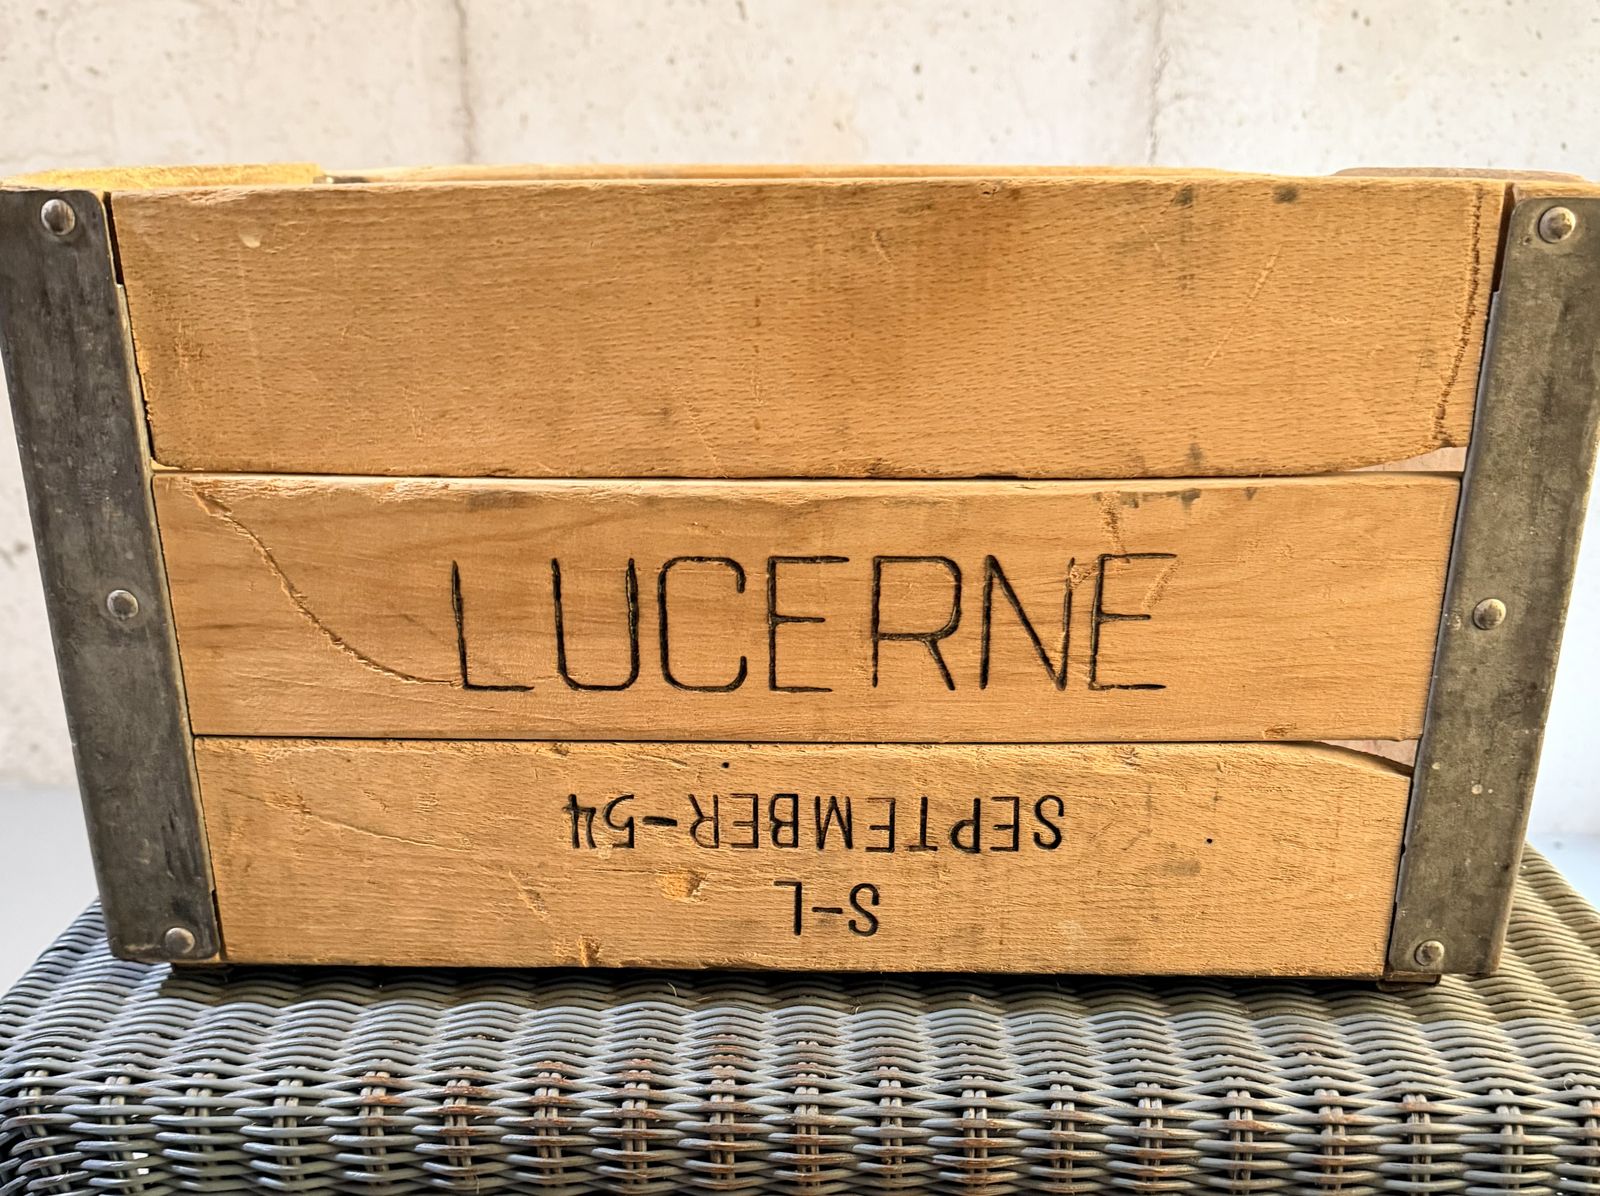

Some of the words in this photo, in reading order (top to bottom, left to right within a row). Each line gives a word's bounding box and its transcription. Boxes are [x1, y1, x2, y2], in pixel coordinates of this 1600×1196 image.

[451, 553, 1178, 692] LUCERNE
[563, 792, 1065, 854] SEPTEMBER-54
[773, 879, 880, 937] S-L
